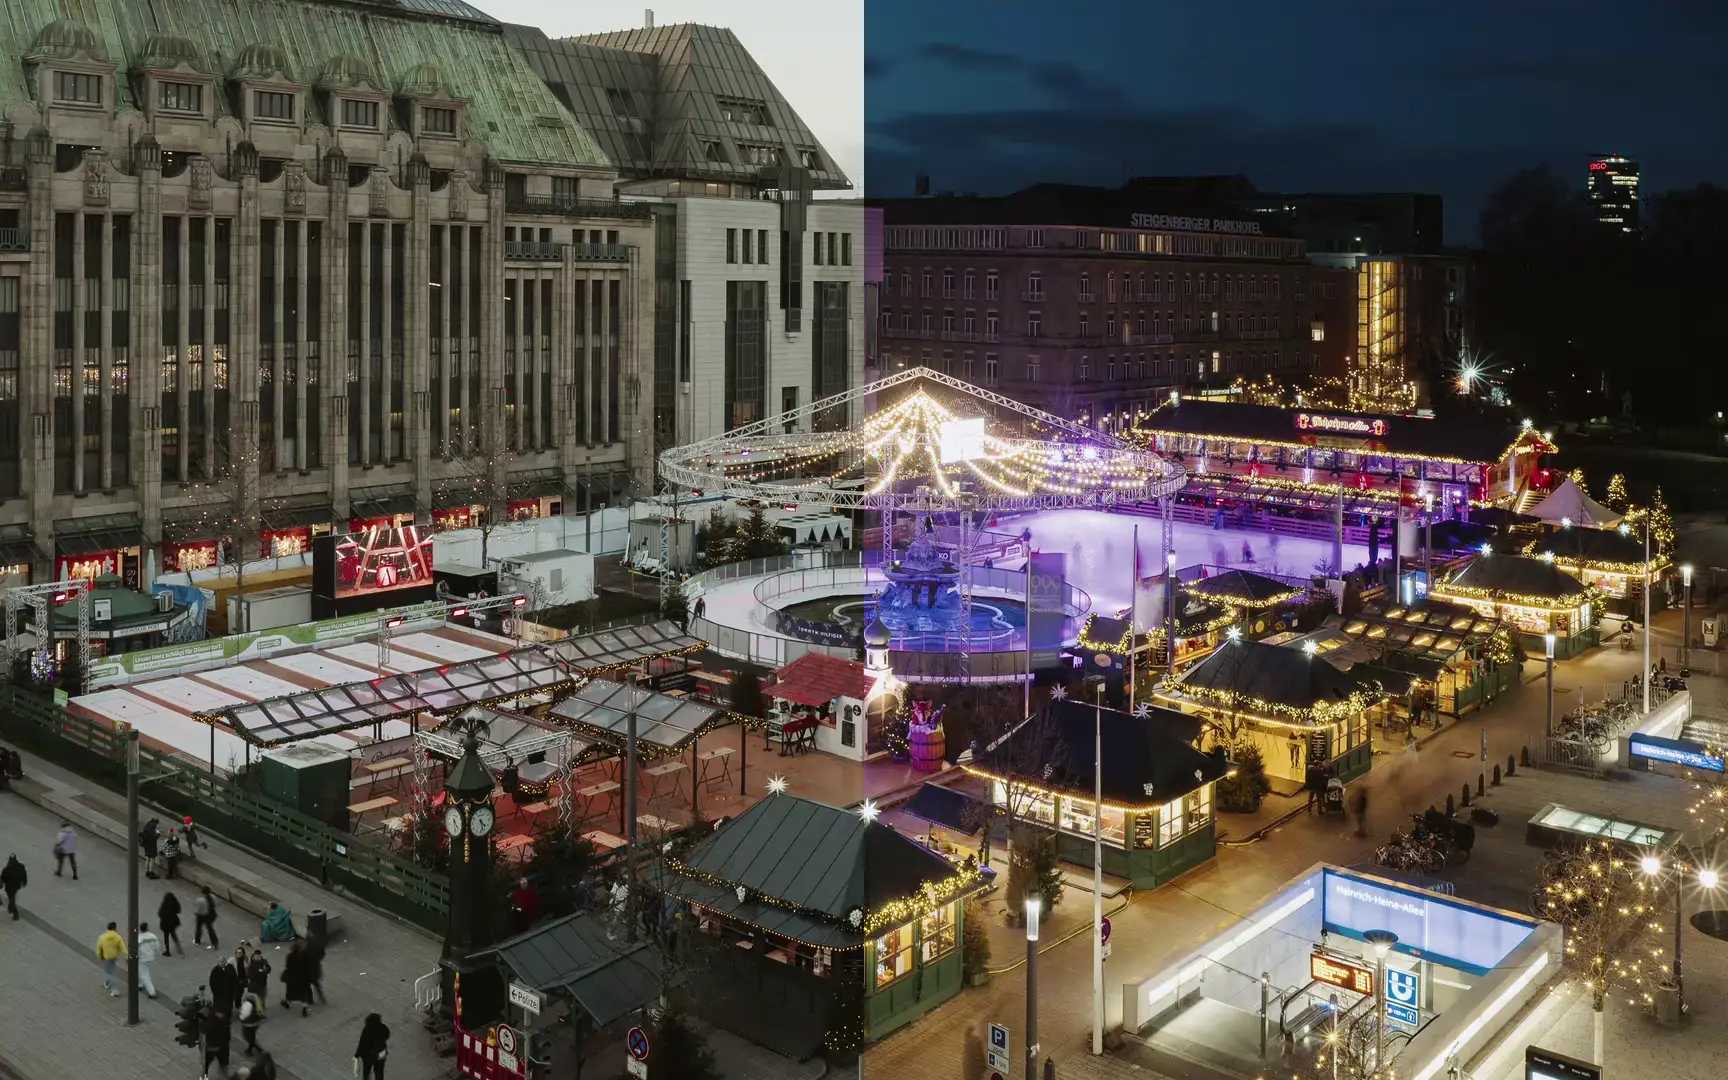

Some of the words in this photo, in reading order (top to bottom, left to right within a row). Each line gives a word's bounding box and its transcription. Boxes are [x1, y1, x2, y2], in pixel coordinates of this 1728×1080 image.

[1590, 162, 1607, 170] ERGO
[1130, 212, 1211, 231] STEIGENBERGER
[1213, 218, 1264, 235] PARKHOTEL
[798, 626, 815, 634] TOMMY
[820, 631, 843, 639] HILFIGER
[151, 653, 165, 661] Herz
[165, 650, 184, 659] schlägt
[193, 643, 223, 654] Düsseldorf.
[1336, 885, 1425, 917] Heinrich-Heine-Allee
[518, 991, 539, 1010] Polizei
[994, 1029, 1002, 1043] P
